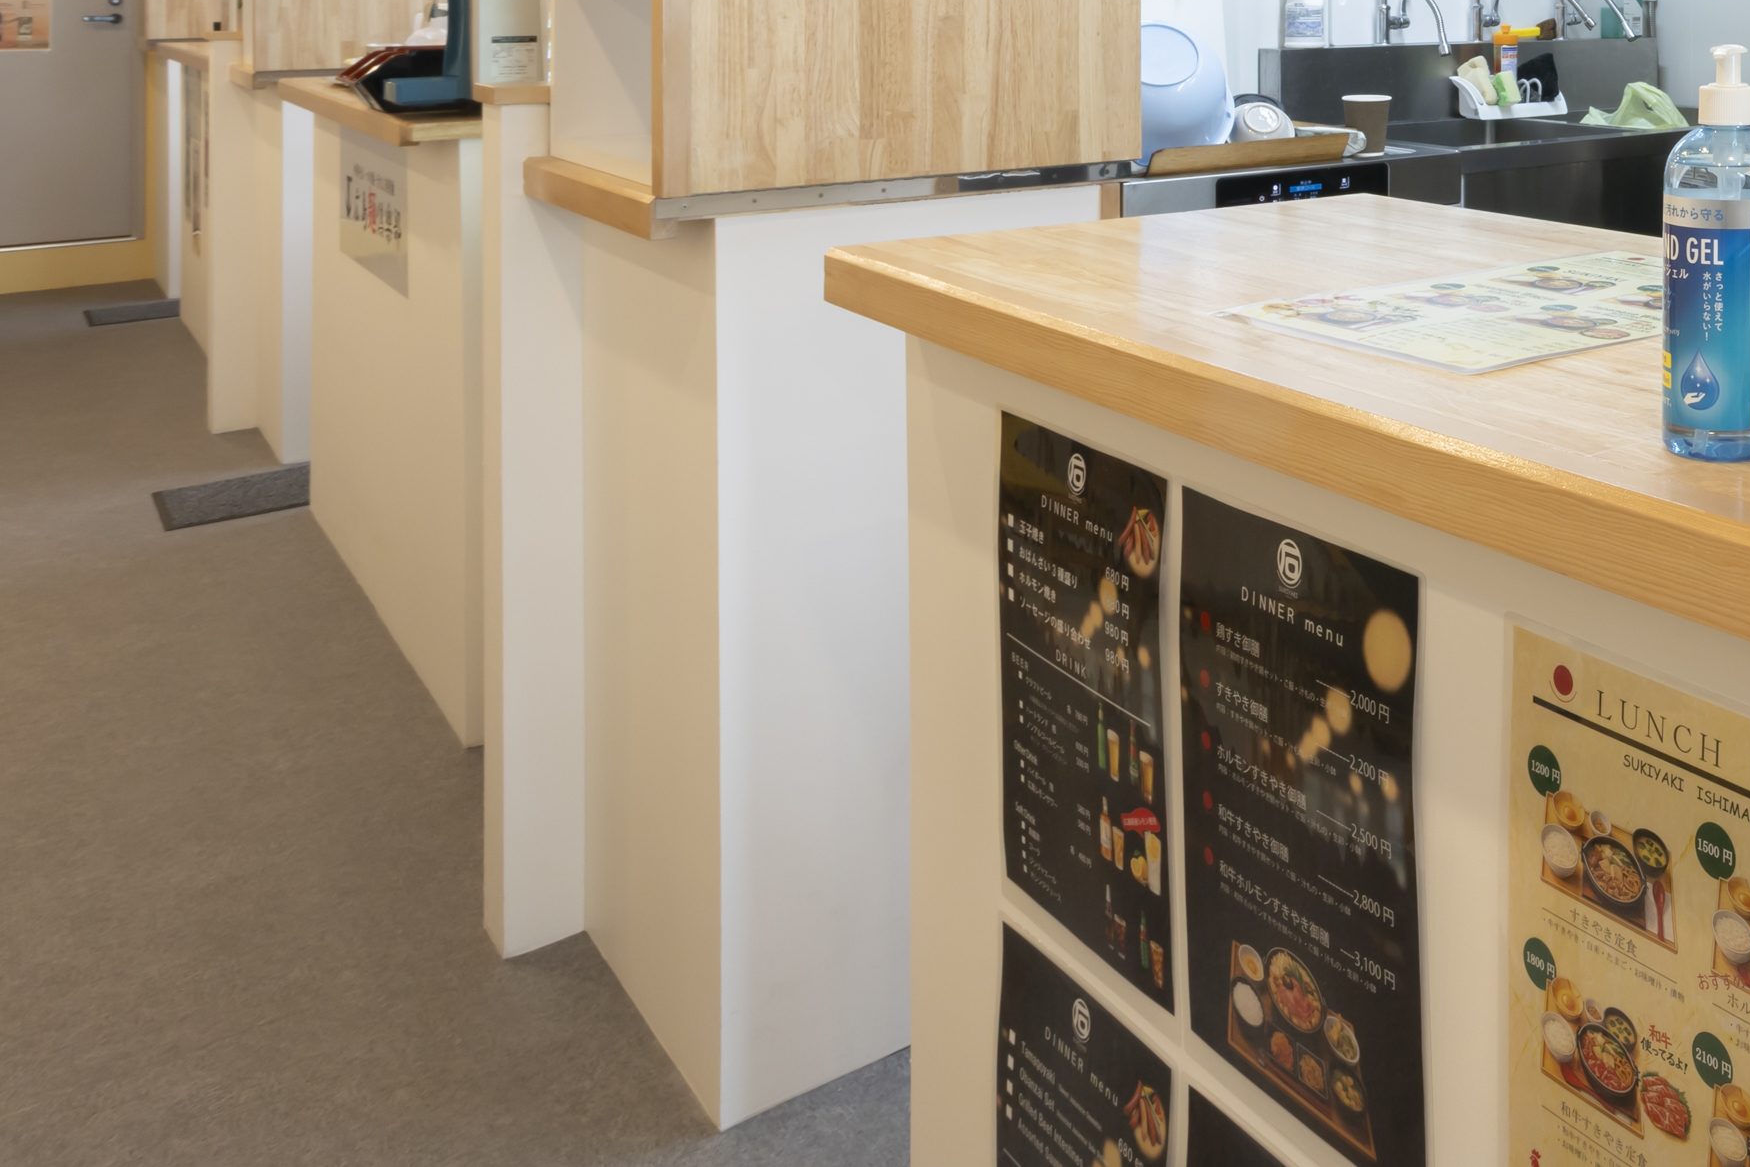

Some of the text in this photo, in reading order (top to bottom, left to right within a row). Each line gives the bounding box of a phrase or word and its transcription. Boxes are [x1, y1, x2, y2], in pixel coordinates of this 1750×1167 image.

[1686, 237, 1724, 266] GEL
[1714, 271, 1724, 333] さっと使えて
[1041, 495, 1079, 525] DINNER
[1086, 518, 1113, 542] menu
[1241, 587, 1295, 624] DINNER
[1305, 618, 1343, 647] menu
[1056, 649, 1087, 679] DRINK
[1596, 690, 1722, 768] LUNCH
[1624, 755, 1685, 792] SUKIYAKI
[1569, 908, 1638, 957] すきやき定食
[1649, 1025, 1673, 1047] 和牛
[1045, 1027, 1118, 1106] DINNER menu
